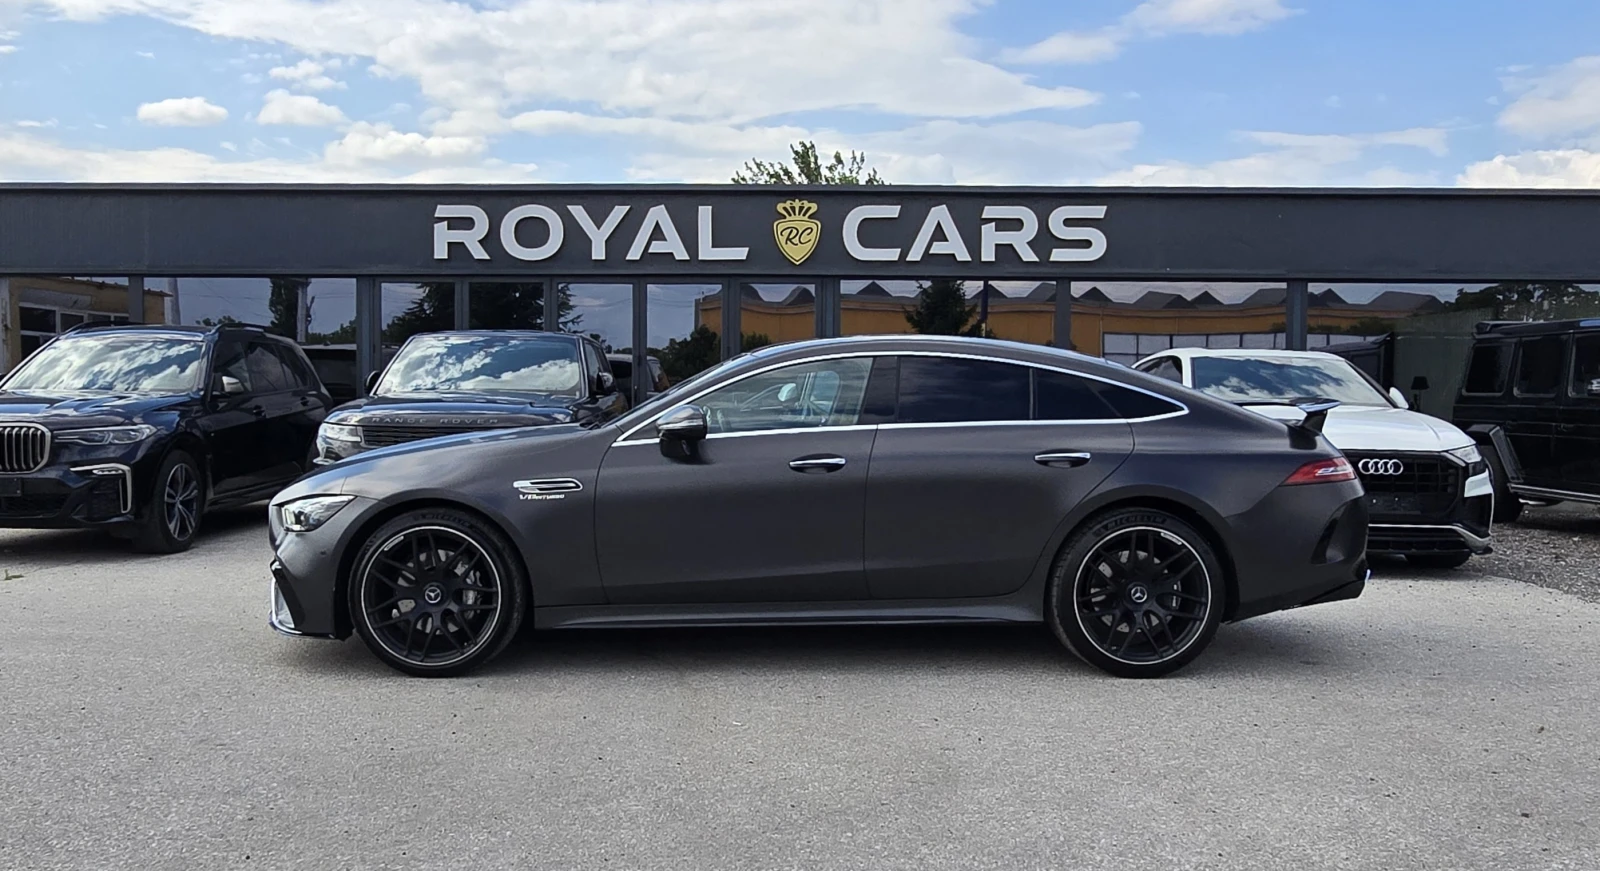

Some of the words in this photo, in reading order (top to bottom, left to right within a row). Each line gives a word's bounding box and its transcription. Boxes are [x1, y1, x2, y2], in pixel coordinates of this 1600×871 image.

[433, 204, 750, 261] ROYAL
[842, 204, 1108, 262] CARS
[780, 226, 814, 246] RC
